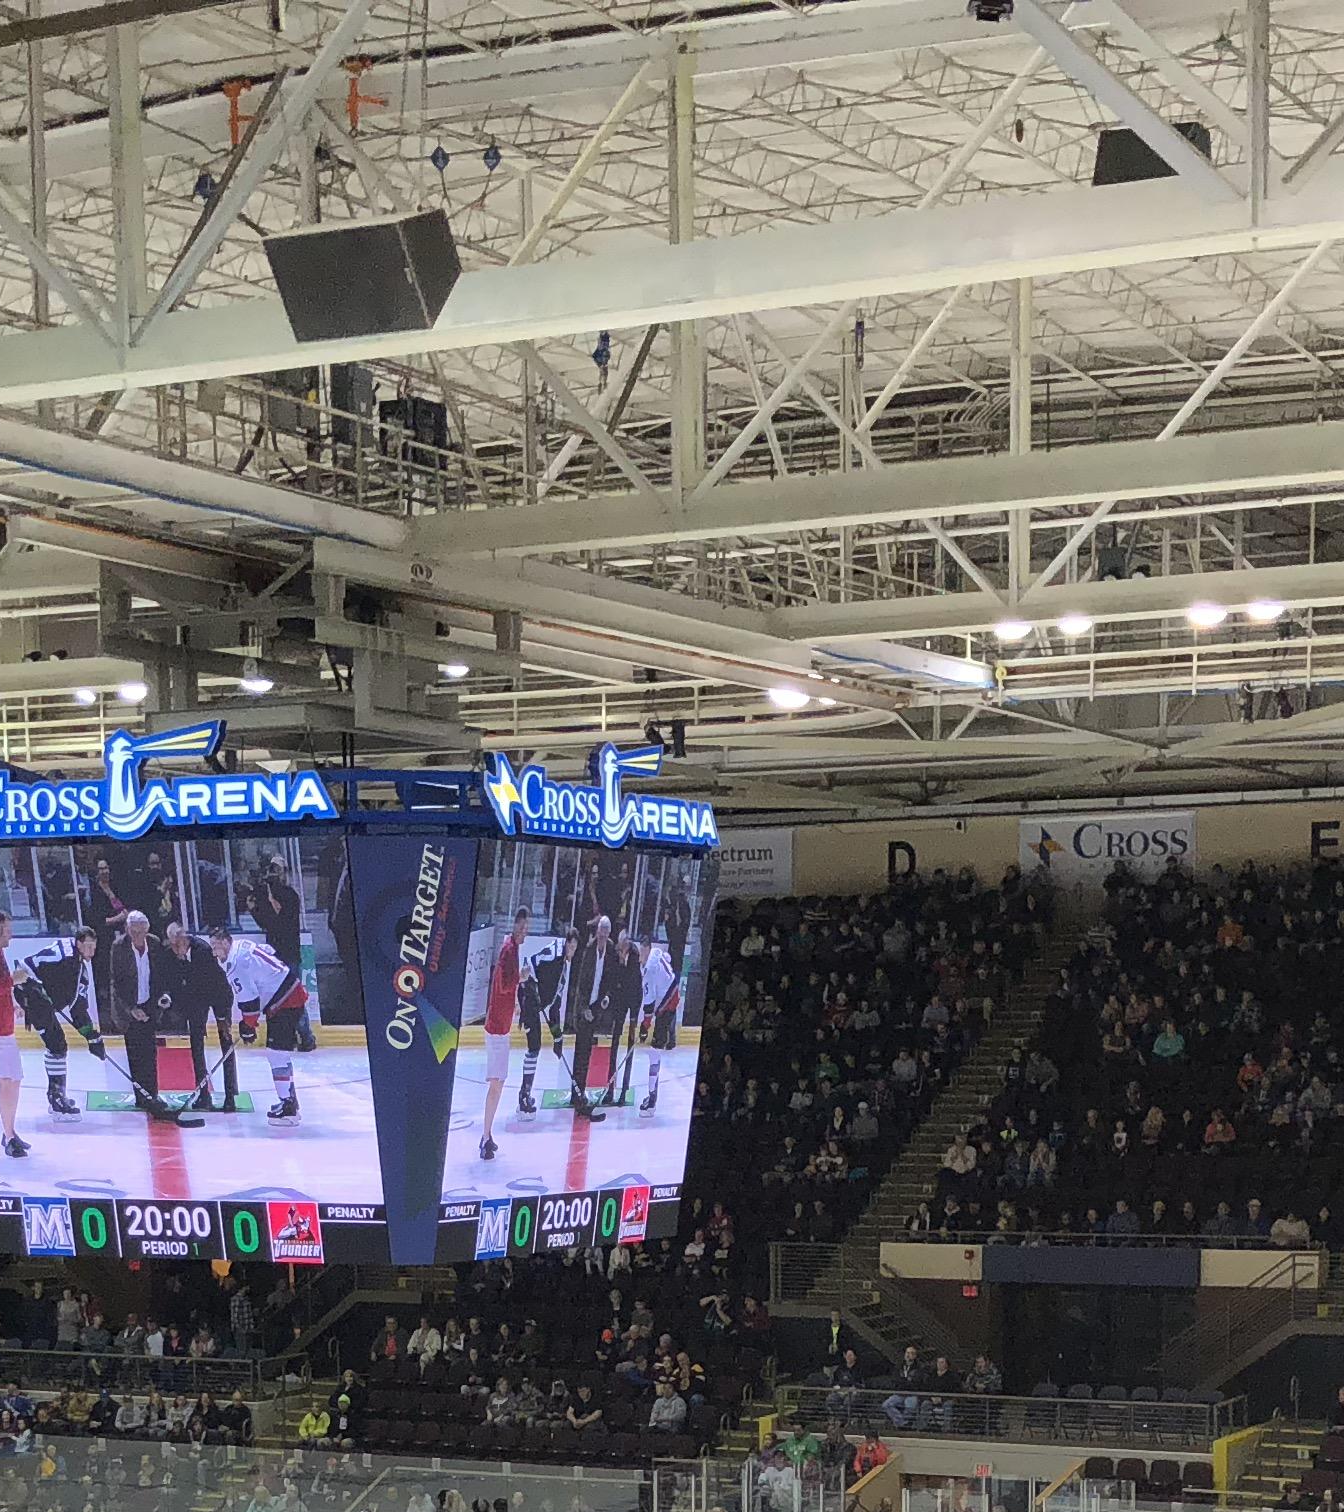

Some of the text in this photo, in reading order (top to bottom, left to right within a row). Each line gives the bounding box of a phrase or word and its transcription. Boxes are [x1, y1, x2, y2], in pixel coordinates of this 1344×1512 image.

[146, 779, 329, 819] ARENA
[521, 771, 717, 839] CROSS ARENA
[702, 847, 774, 864] pectrum
[1073, 823, 1189, 859] CROSS
[888, 841, 916, 882] D
[386, 843, 444, 1051] ON TARGET
[81, 1207, 107, 1249] 0
[124, 1204, 212, 1238] 20:00
[327, 1206, 376, 1220] PENALTY
[445, 1204, 477, 1218] PENALTY
[514, 1205, 531, 1247] 0
[541, 1196, 593, 1232] 20:00
[601, 1197, 617, 1237] 0
[141, 1240, 200, 1257] PERIOD 1
[233, 1210, 259, 1254] 0
[547, 1232, 575, 1249] PERIOD
